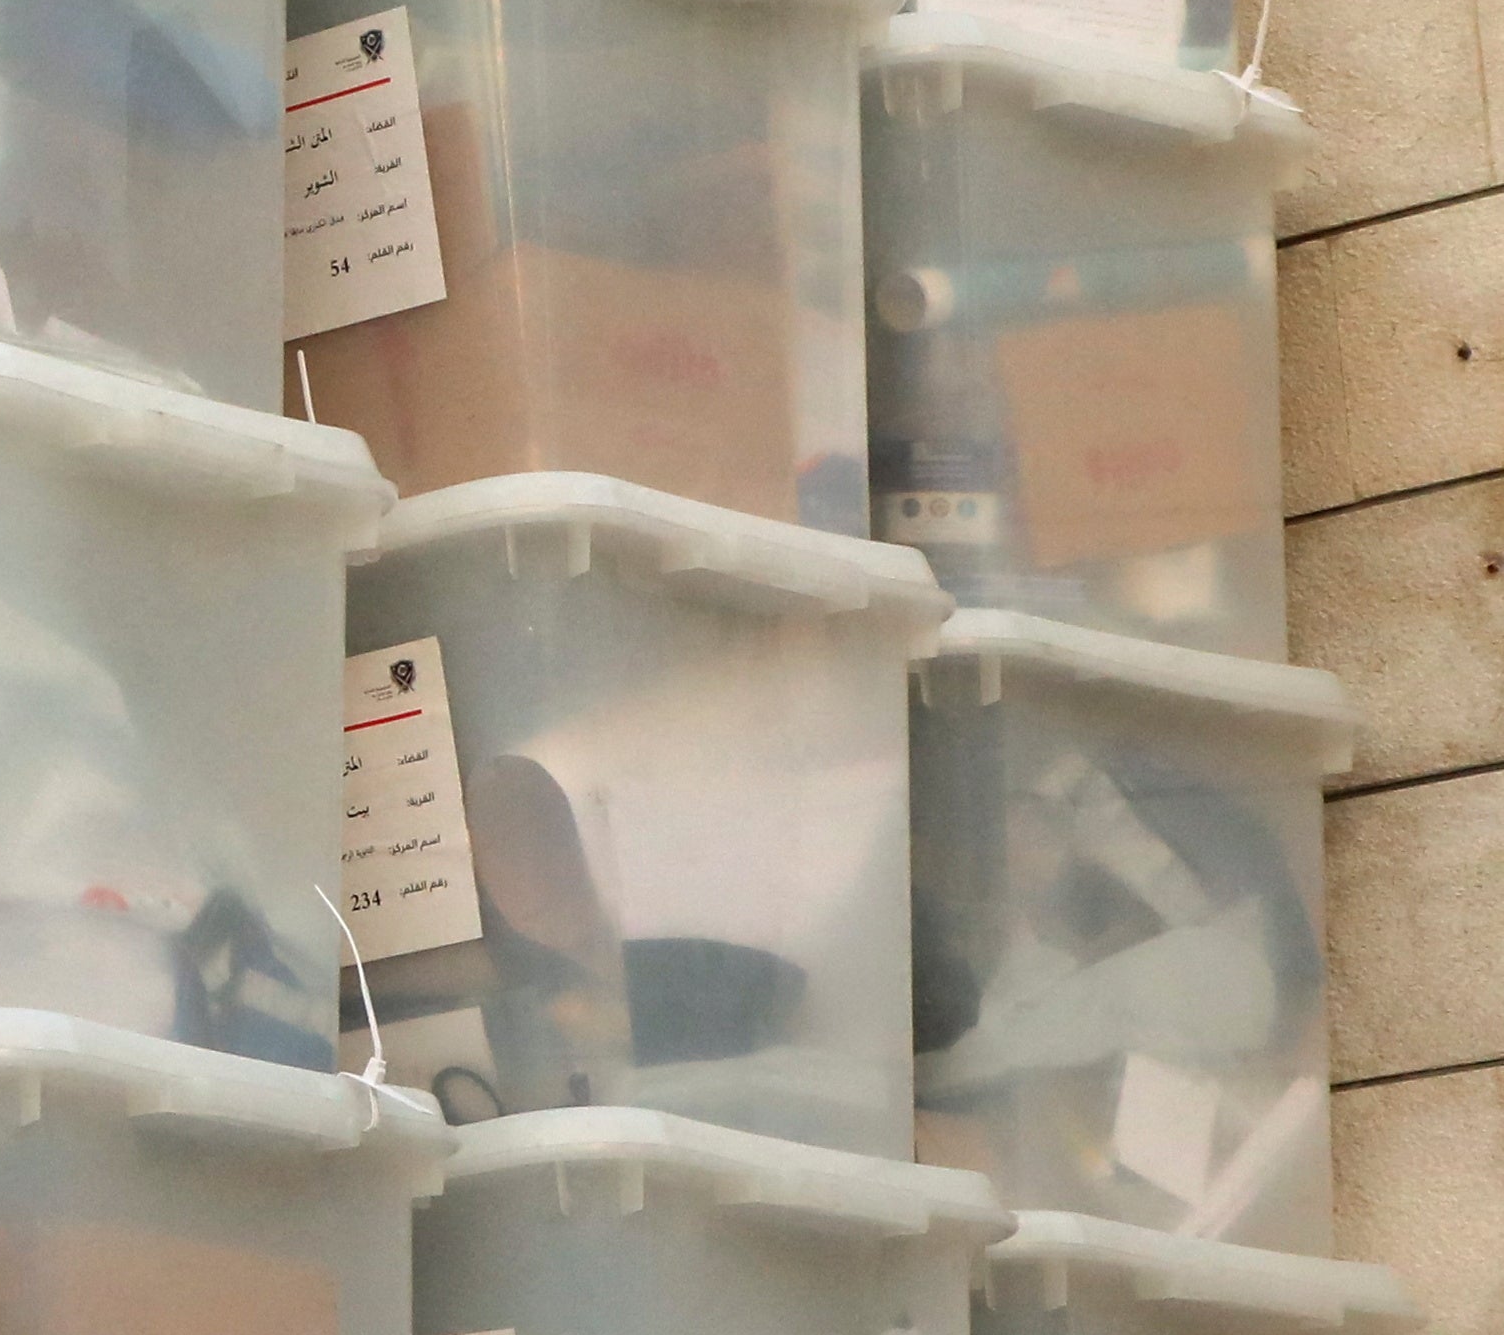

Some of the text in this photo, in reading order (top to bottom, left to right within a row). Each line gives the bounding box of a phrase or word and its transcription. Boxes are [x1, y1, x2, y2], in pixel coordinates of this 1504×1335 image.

[330, 241, 414, 278] رقم القلم: 54
[350, 878, 448, 912] رقم القلم: 234
